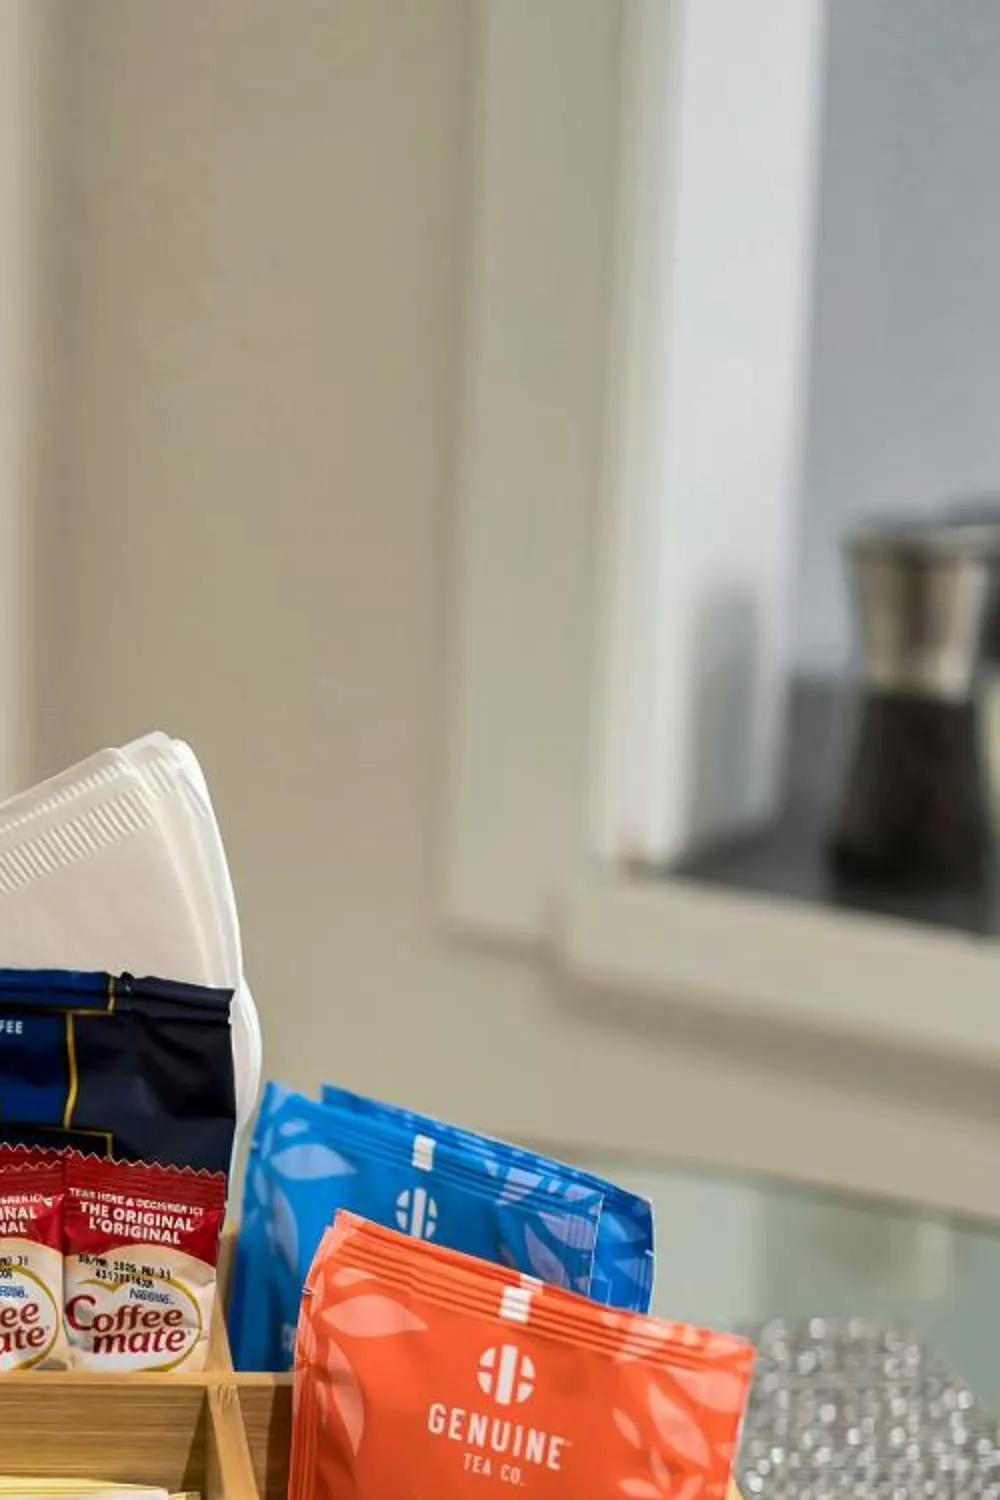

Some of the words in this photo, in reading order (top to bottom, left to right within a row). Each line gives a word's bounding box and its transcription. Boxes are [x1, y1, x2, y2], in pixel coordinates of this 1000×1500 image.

[79, 1201, 110, 1219] THE
[112, 1207, 195, 1232] ORIGINAL
[89, 1216, 182, 1245] L'ORIGINAL
[64, 1294, 183, 1333] Coffee
[91, 1326, 186, 1355] mate
[427, 1402, 565, 1472] GENUINE
[463, 1452, 493, 1477] TEA
